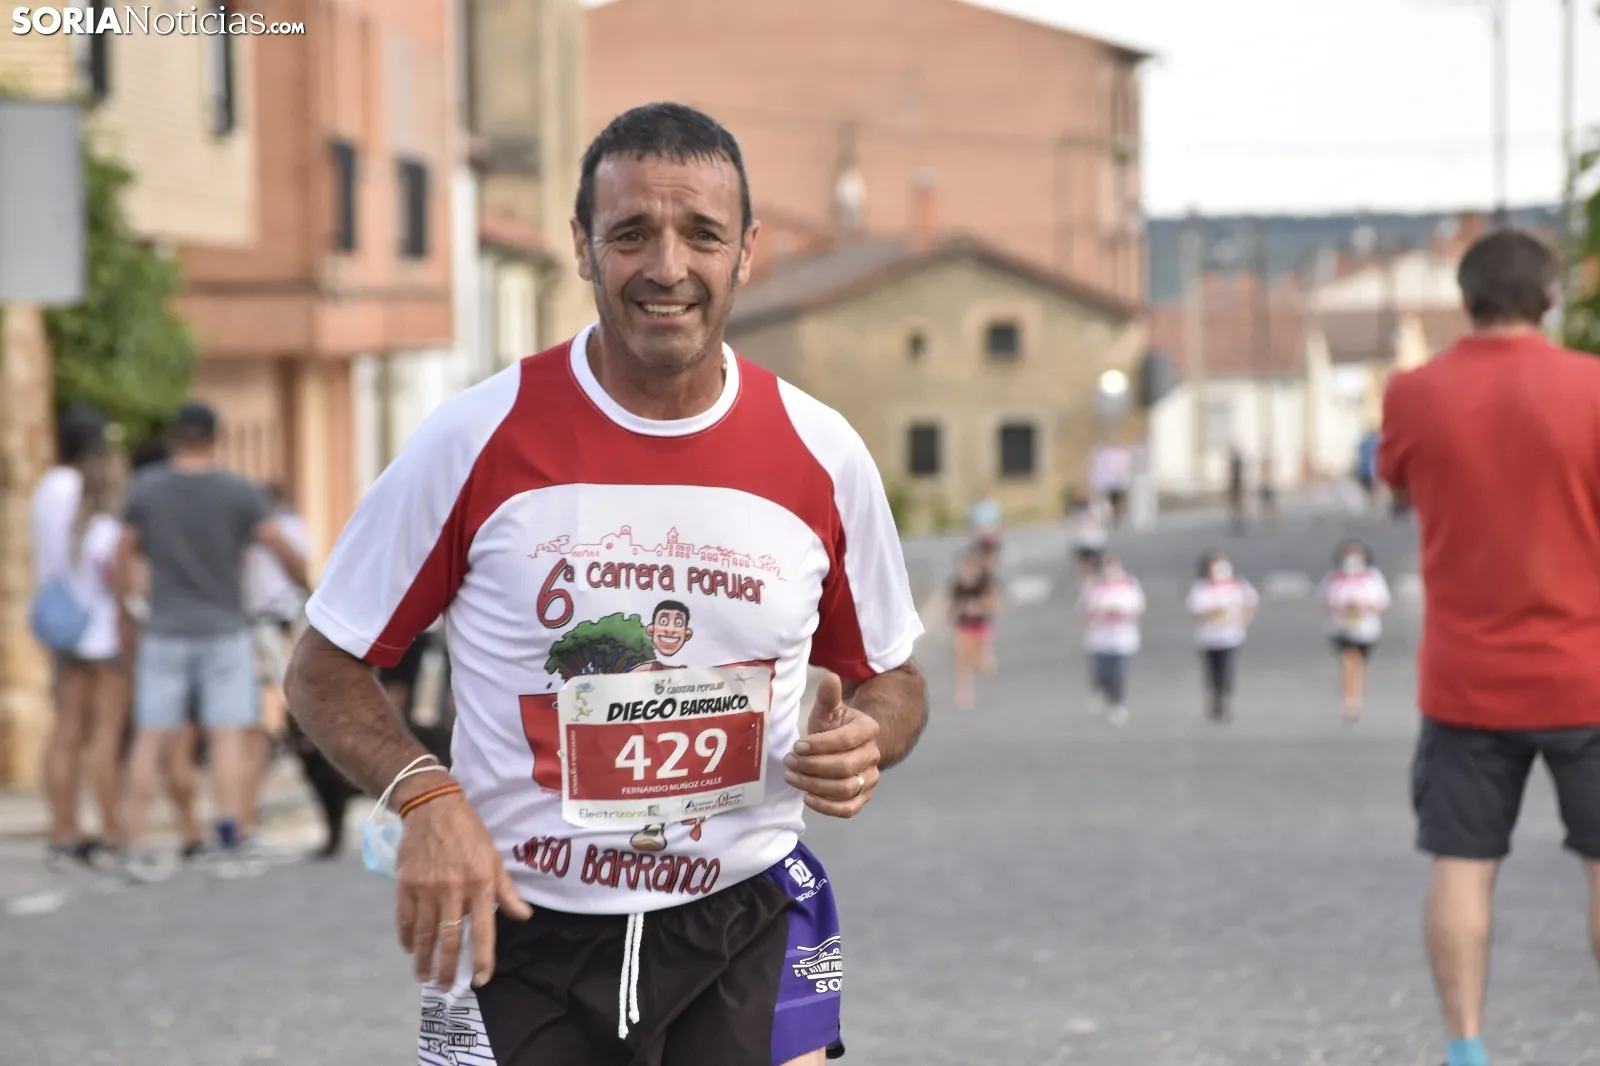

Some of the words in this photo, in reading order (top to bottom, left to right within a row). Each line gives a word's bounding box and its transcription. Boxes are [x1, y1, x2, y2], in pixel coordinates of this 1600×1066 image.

[606, 697, 677, 722] DIEGO
[679, 694, 749, 717] BARRANCO
[615, 727, 728, 781] 429
[621, 783, 668, 795] FERNANDO
[669, 780, 699, 792] MUÑOZ
[700, 776, 723, 787] CALLE
[815, 978, 842, 993] SO
